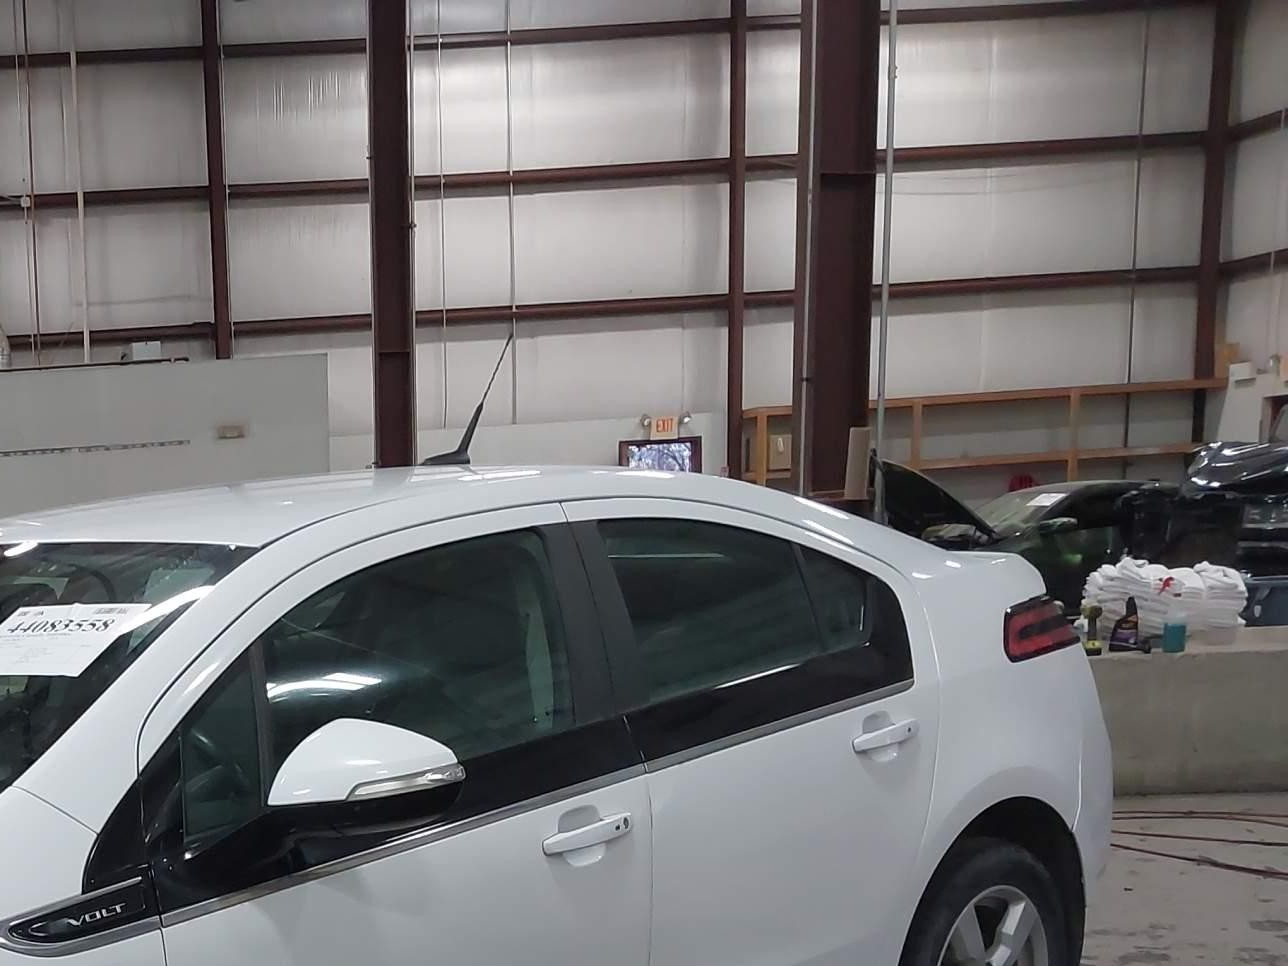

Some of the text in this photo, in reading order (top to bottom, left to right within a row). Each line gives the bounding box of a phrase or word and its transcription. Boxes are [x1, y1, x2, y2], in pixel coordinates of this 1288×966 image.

[656, 417, 674, 433] EXIT
[7, 618, 115, 634] 44083558
[65, 902, 126, 926] VOLT
